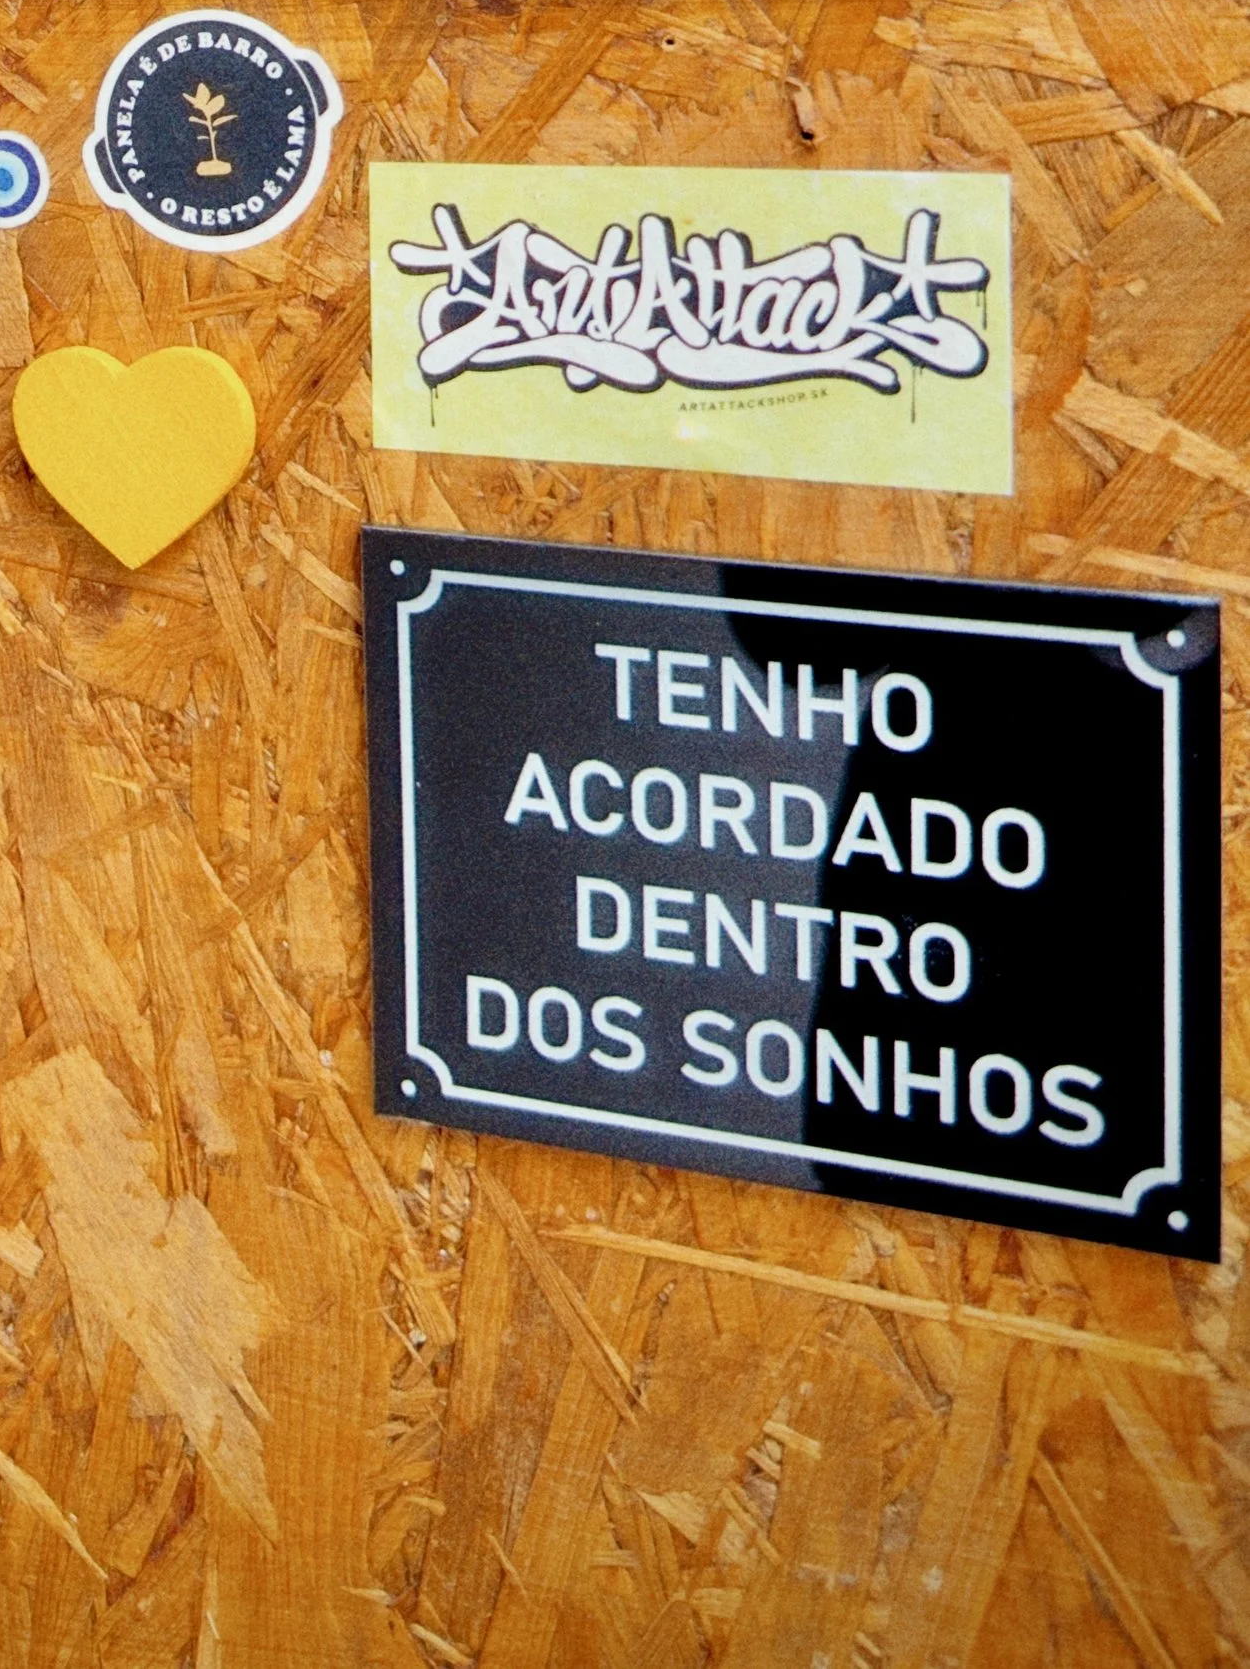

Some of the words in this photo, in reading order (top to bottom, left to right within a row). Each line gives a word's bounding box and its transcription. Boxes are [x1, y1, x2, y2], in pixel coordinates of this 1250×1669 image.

[116, 79, 146, 184] PANELA
[138, 55, 158, 76] É
[156, 34, 192, 62] DE
[197, 31, 284, 80] BARRO
[160, 197, 178, 215] O
[180, 195, 265, 226] RESTO
[262, 179, 283, 200] É
[275, 104, 306, 182] LAMA
[595, 643, 934, 752] TENHO
[503, 752, 1046, 890] ACORDADO
[575, 875, 972, 1002] DENTRO
[466, 974, 647, 1072] DOS
[680, 1010, 1106, 1147] SONHOS
